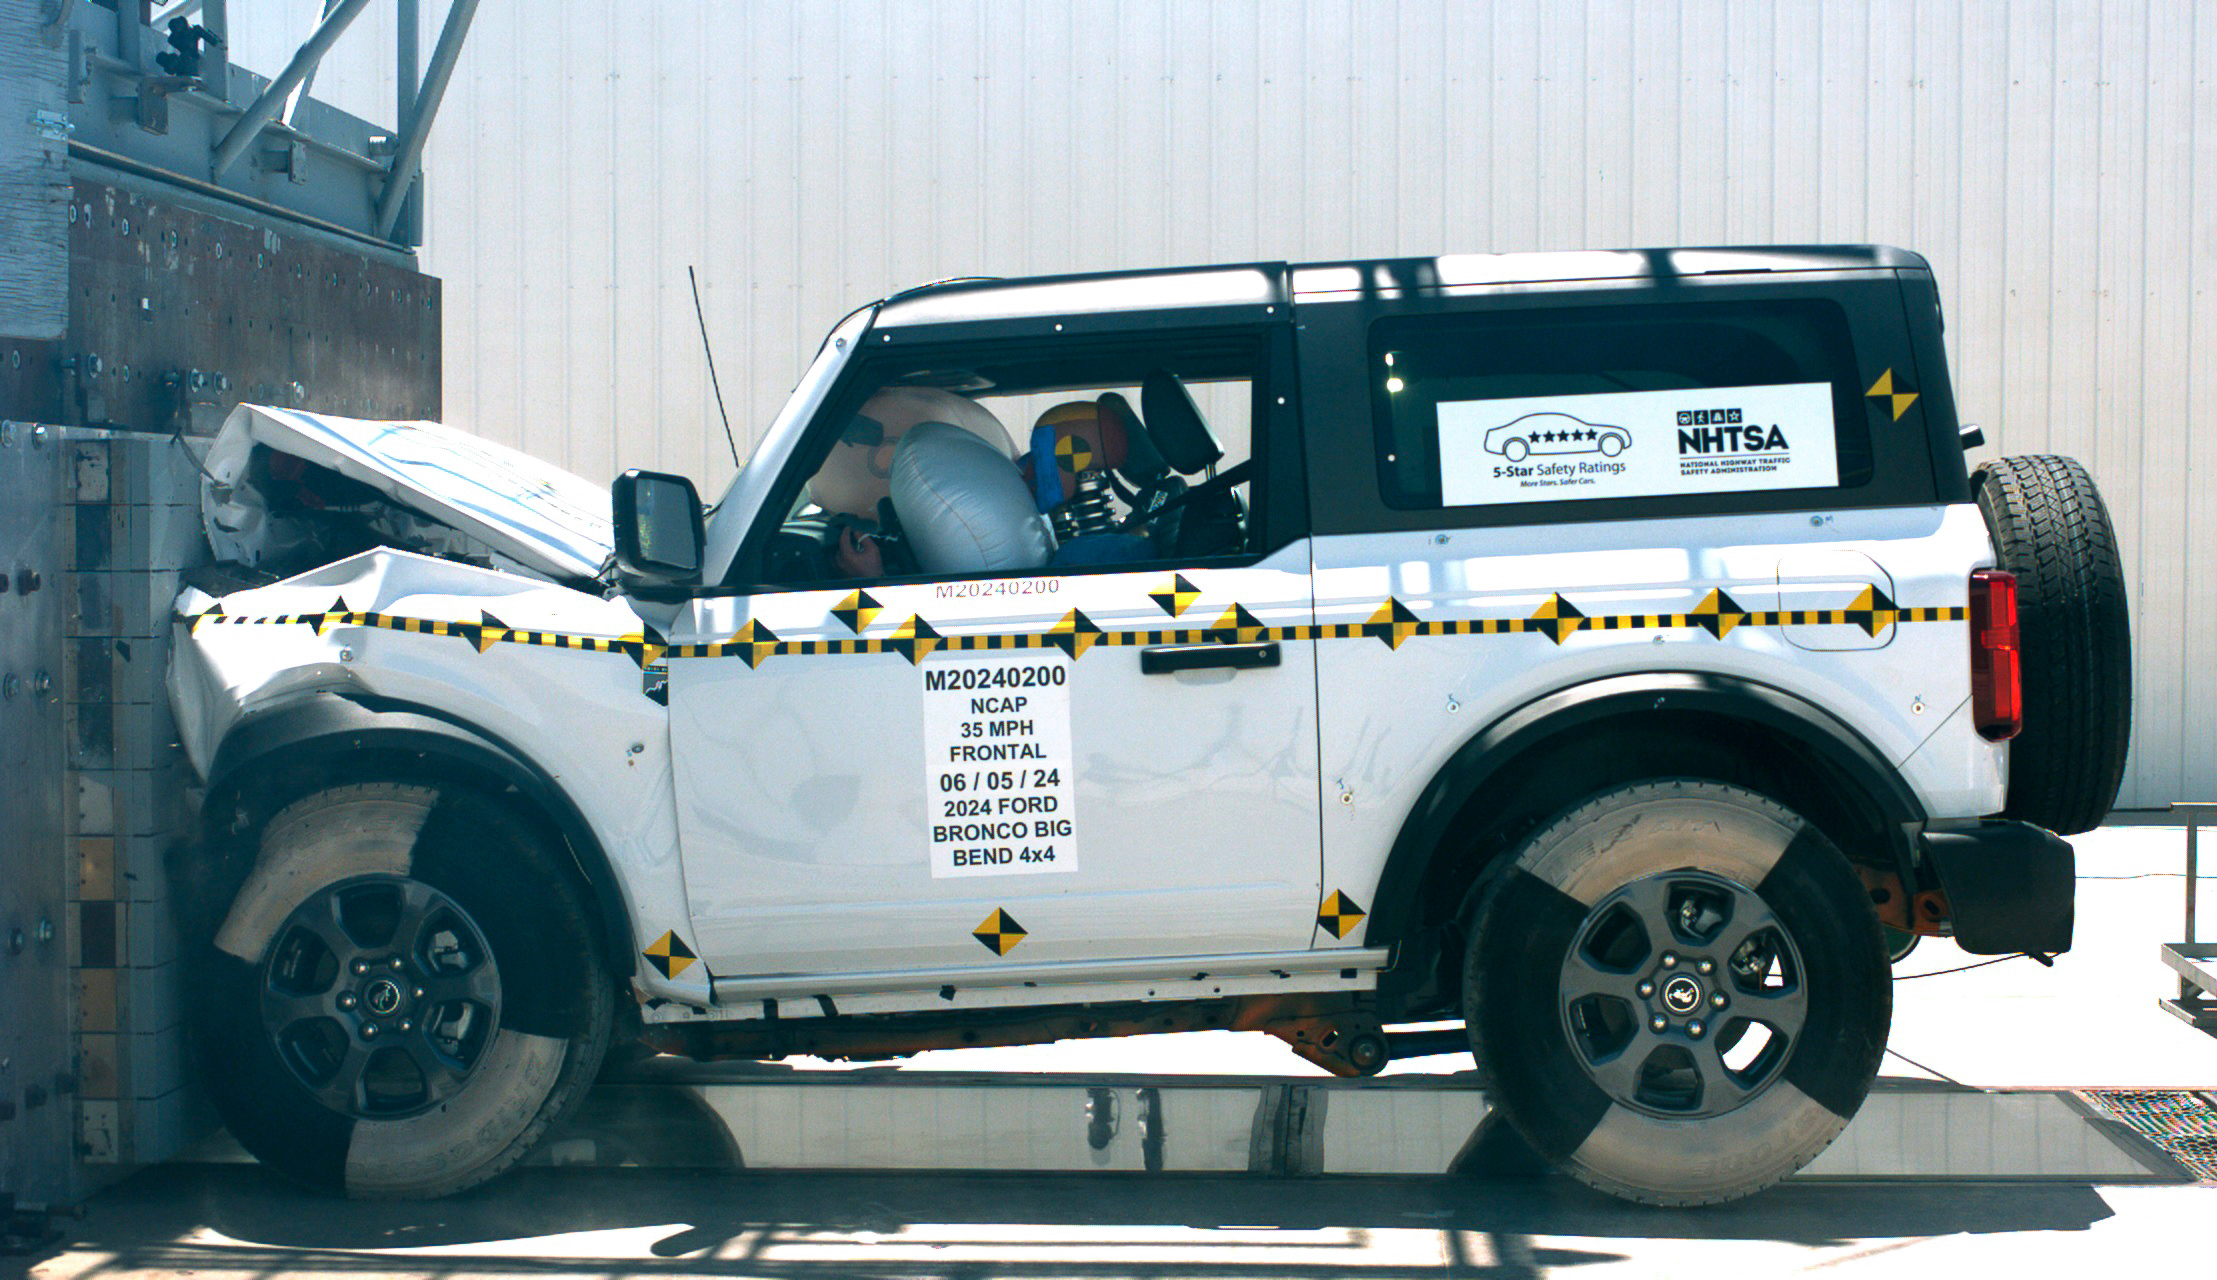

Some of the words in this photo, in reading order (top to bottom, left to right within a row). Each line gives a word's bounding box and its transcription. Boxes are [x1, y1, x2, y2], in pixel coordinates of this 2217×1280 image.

[1678, 424, 1789, 454] NHTSA
[1493, 464, 1533, 478] 5-Star
[1537, 462, 1576, 478] Safety
[1579, 461, 1626, 477] Ratings
[1680, 460, 1718, 468] NATIONAL
[1711, 465, 1777, 474] ADMINISTRATION
[936, 579, 1059, 599] M20240200
[926, 665, 1066, 690] M20240200
[971, 697, 1028, 714] NCAP
[961, 722, 983, 737] 35
[989, 720, 1033, 736] MPH
[950, 744, 1046, 762] FRONTAL
[940, 773, 966, 792] 06
[973, 772, 980, 791] /
[987, 771, 1013, 790] 05
[1020, 770, 1027, 789] /
[1034, 769, 1060, 787] 24
[945, 800, 992, 817] 2024
[999, 796, 1058, 814] FORD
[934, 822, 1027, 842] BRONCO
[1035, 820, 1072, 837] BIG
[953, 847, 1013, 866] BEND
[1019, 846, 1055, 863] 4x4
